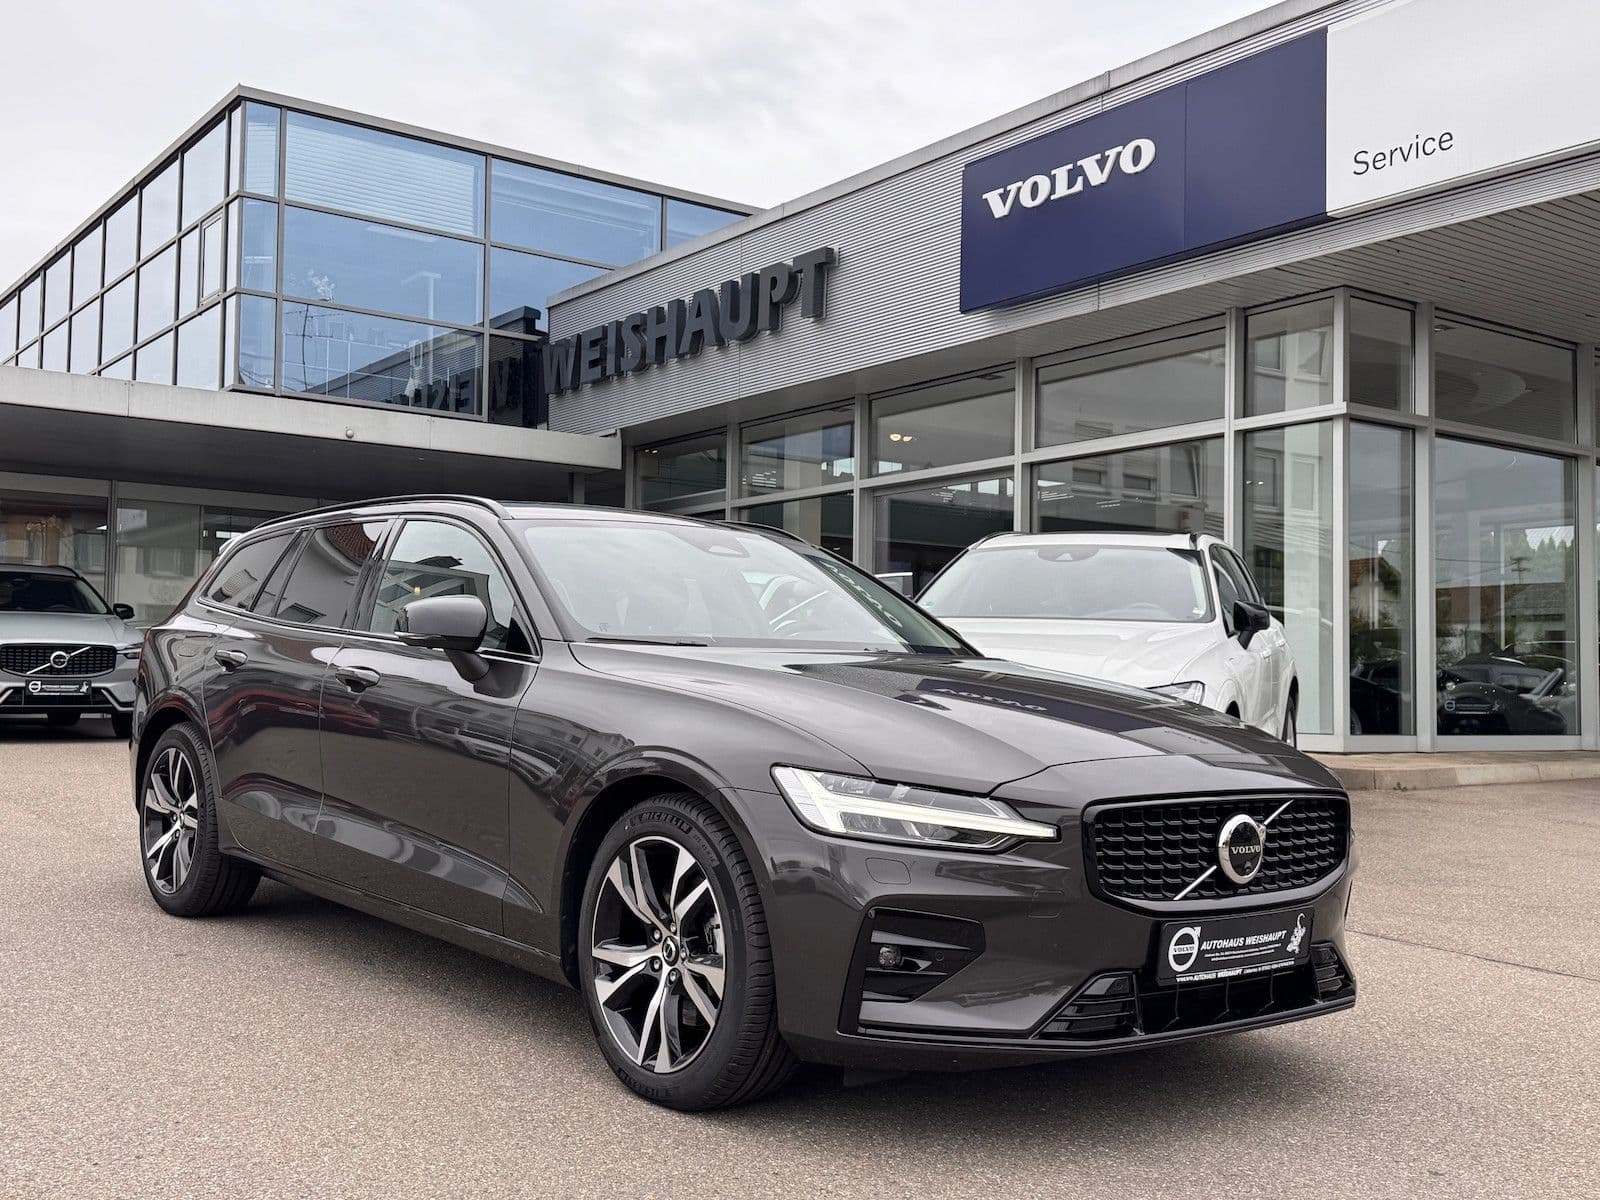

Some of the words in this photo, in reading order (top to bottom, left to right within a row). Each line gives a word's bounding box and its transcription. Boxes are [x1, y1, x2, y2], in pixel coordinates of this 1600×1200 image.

[1352, 131, 1453, 175] Service
[982, 138, 1156, 219] VOLVO
[541, 246, 839, 397] WEISHAUPT
[1231, 844, 1261, 854] VOLVO
[1200, 938, 1244, 951] AUTOHAUS
[1245, 930, 1287, 946] WEISHAUPT
